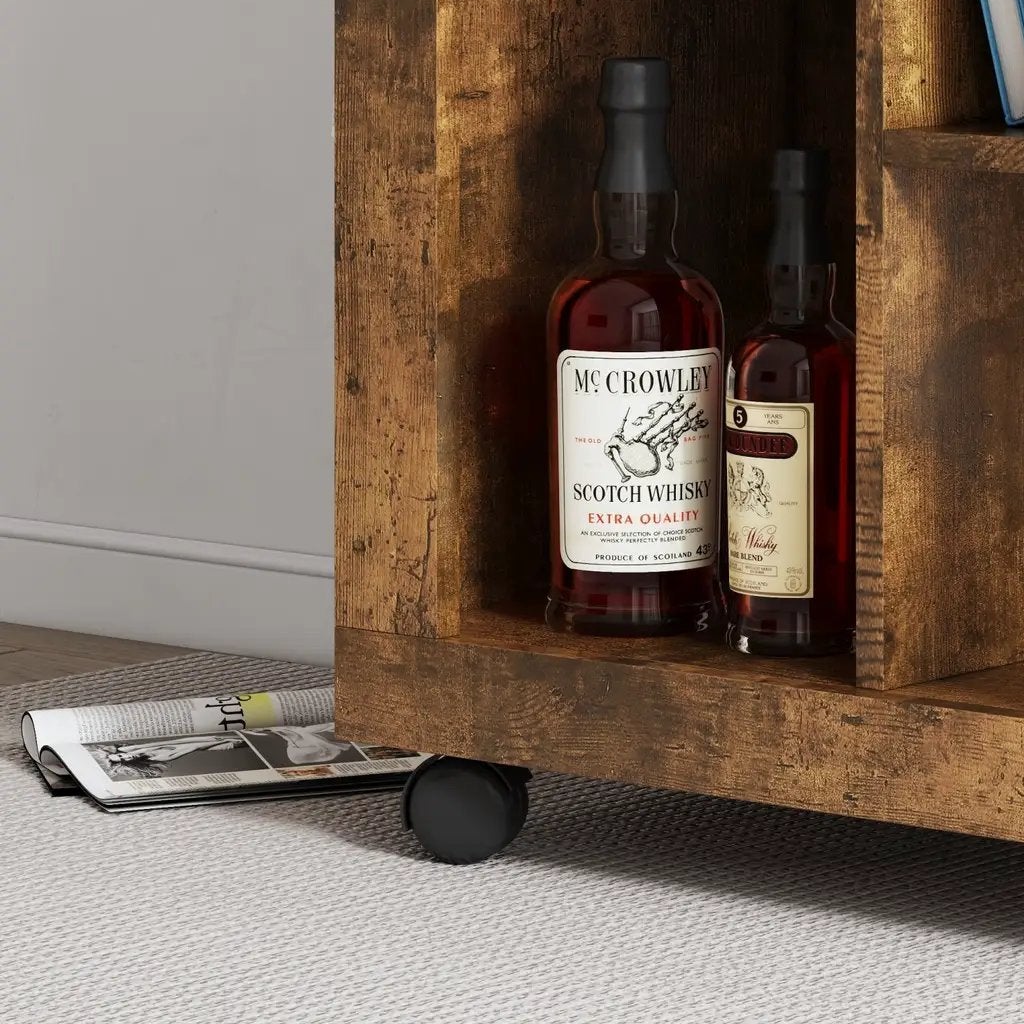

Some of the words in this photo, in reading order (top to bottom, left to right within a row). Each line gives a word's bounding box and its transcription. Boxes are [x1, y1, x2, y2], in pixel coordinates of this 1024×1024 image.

[605, 366, 711, 394] CROWLEY
[736, 410, 743, 424] 5
[573, 483, 641, 503] SCOTCH
[648, 479, 711, 502] WHISKY
[588, 513, 633, 525] EXTRA
[640, 510, 700, 525] QUALITY
[653, 551, 692, 561] SCOTLAND
[741, 552, 764, 562] BLEND
